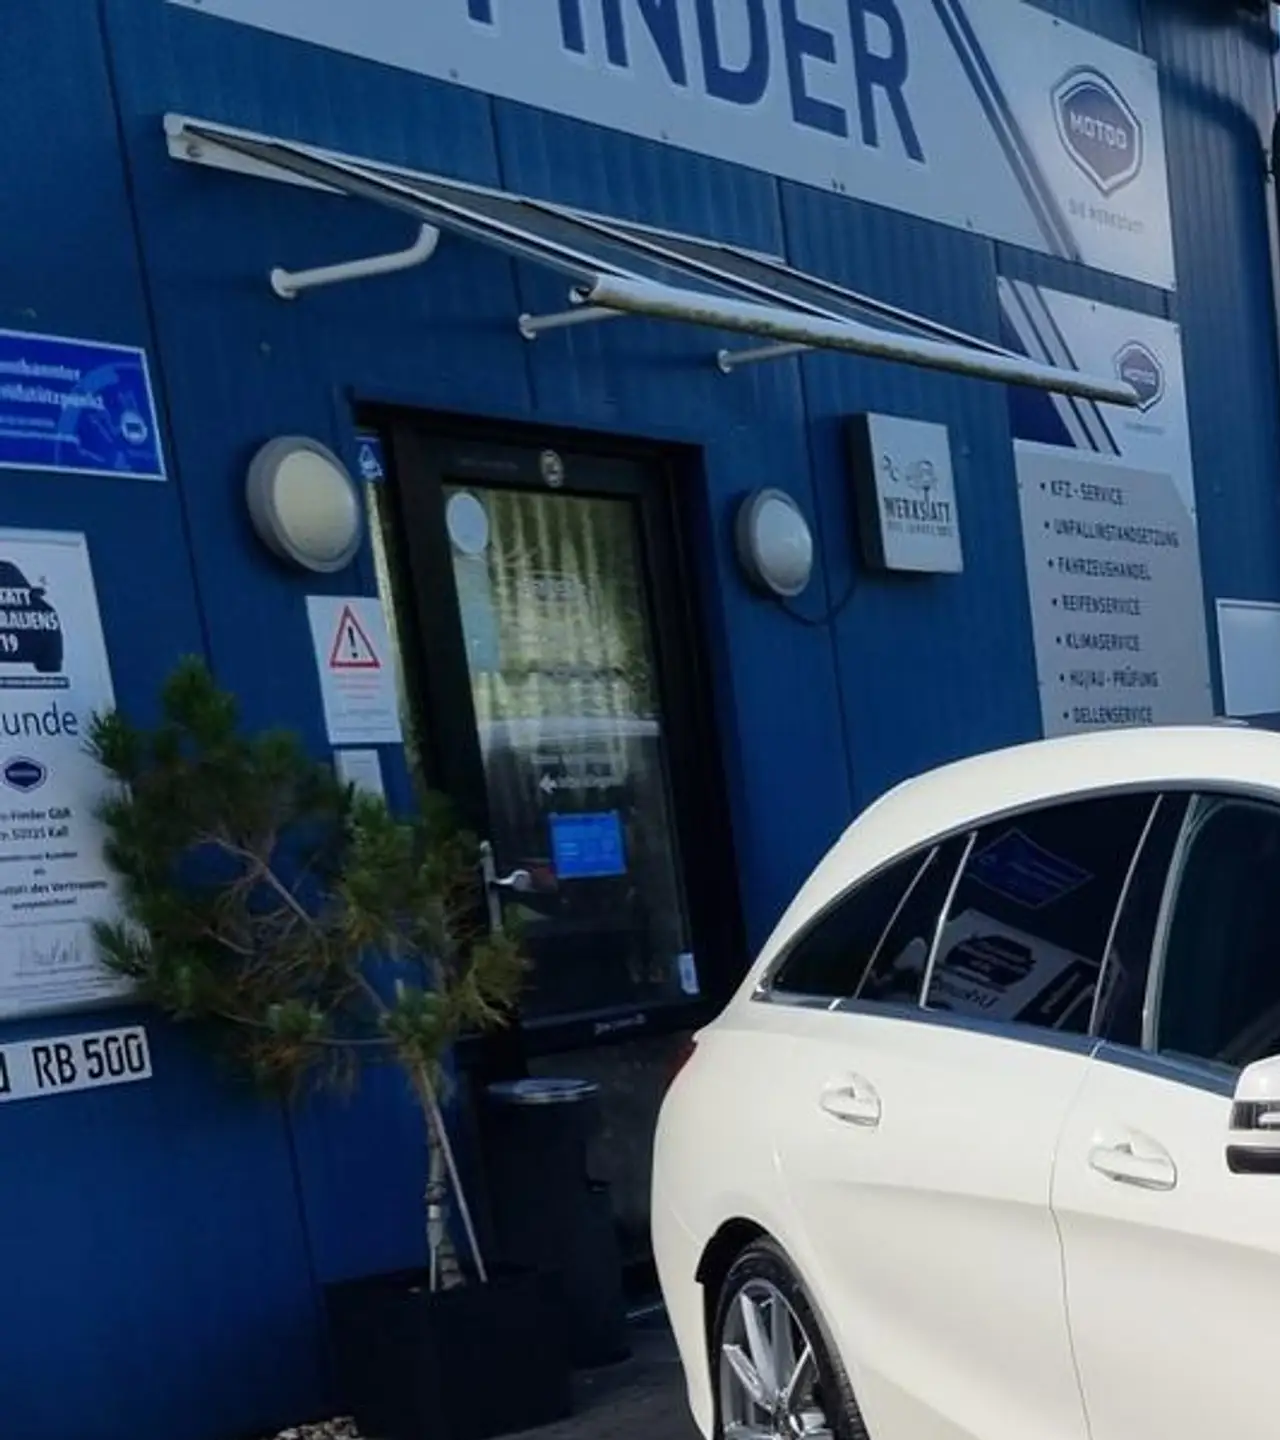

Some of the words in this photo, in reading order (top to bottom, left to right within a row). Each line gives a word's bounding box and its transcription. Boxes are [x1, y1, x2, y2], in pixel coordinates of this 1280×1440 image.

[467, 0, 926, 163] DER
[1069, 111, 1128, 151] MOTOO
[883, 488, 950, 523] WERKSTATT
[1058, 556, 1152, 581] FAHRZEUGHANDEL
[1062, 594, 1141, 616] REIFENSERVICE
[1065, 632, 1140, 652] KLIMASERVICE
[0, 701, 78, 736] unde
[1073, 705, 1152, 724] DELLENSERVICE
[32, 1042, 77, 1088] RB
[82, 1033, 145, 1079] 500
